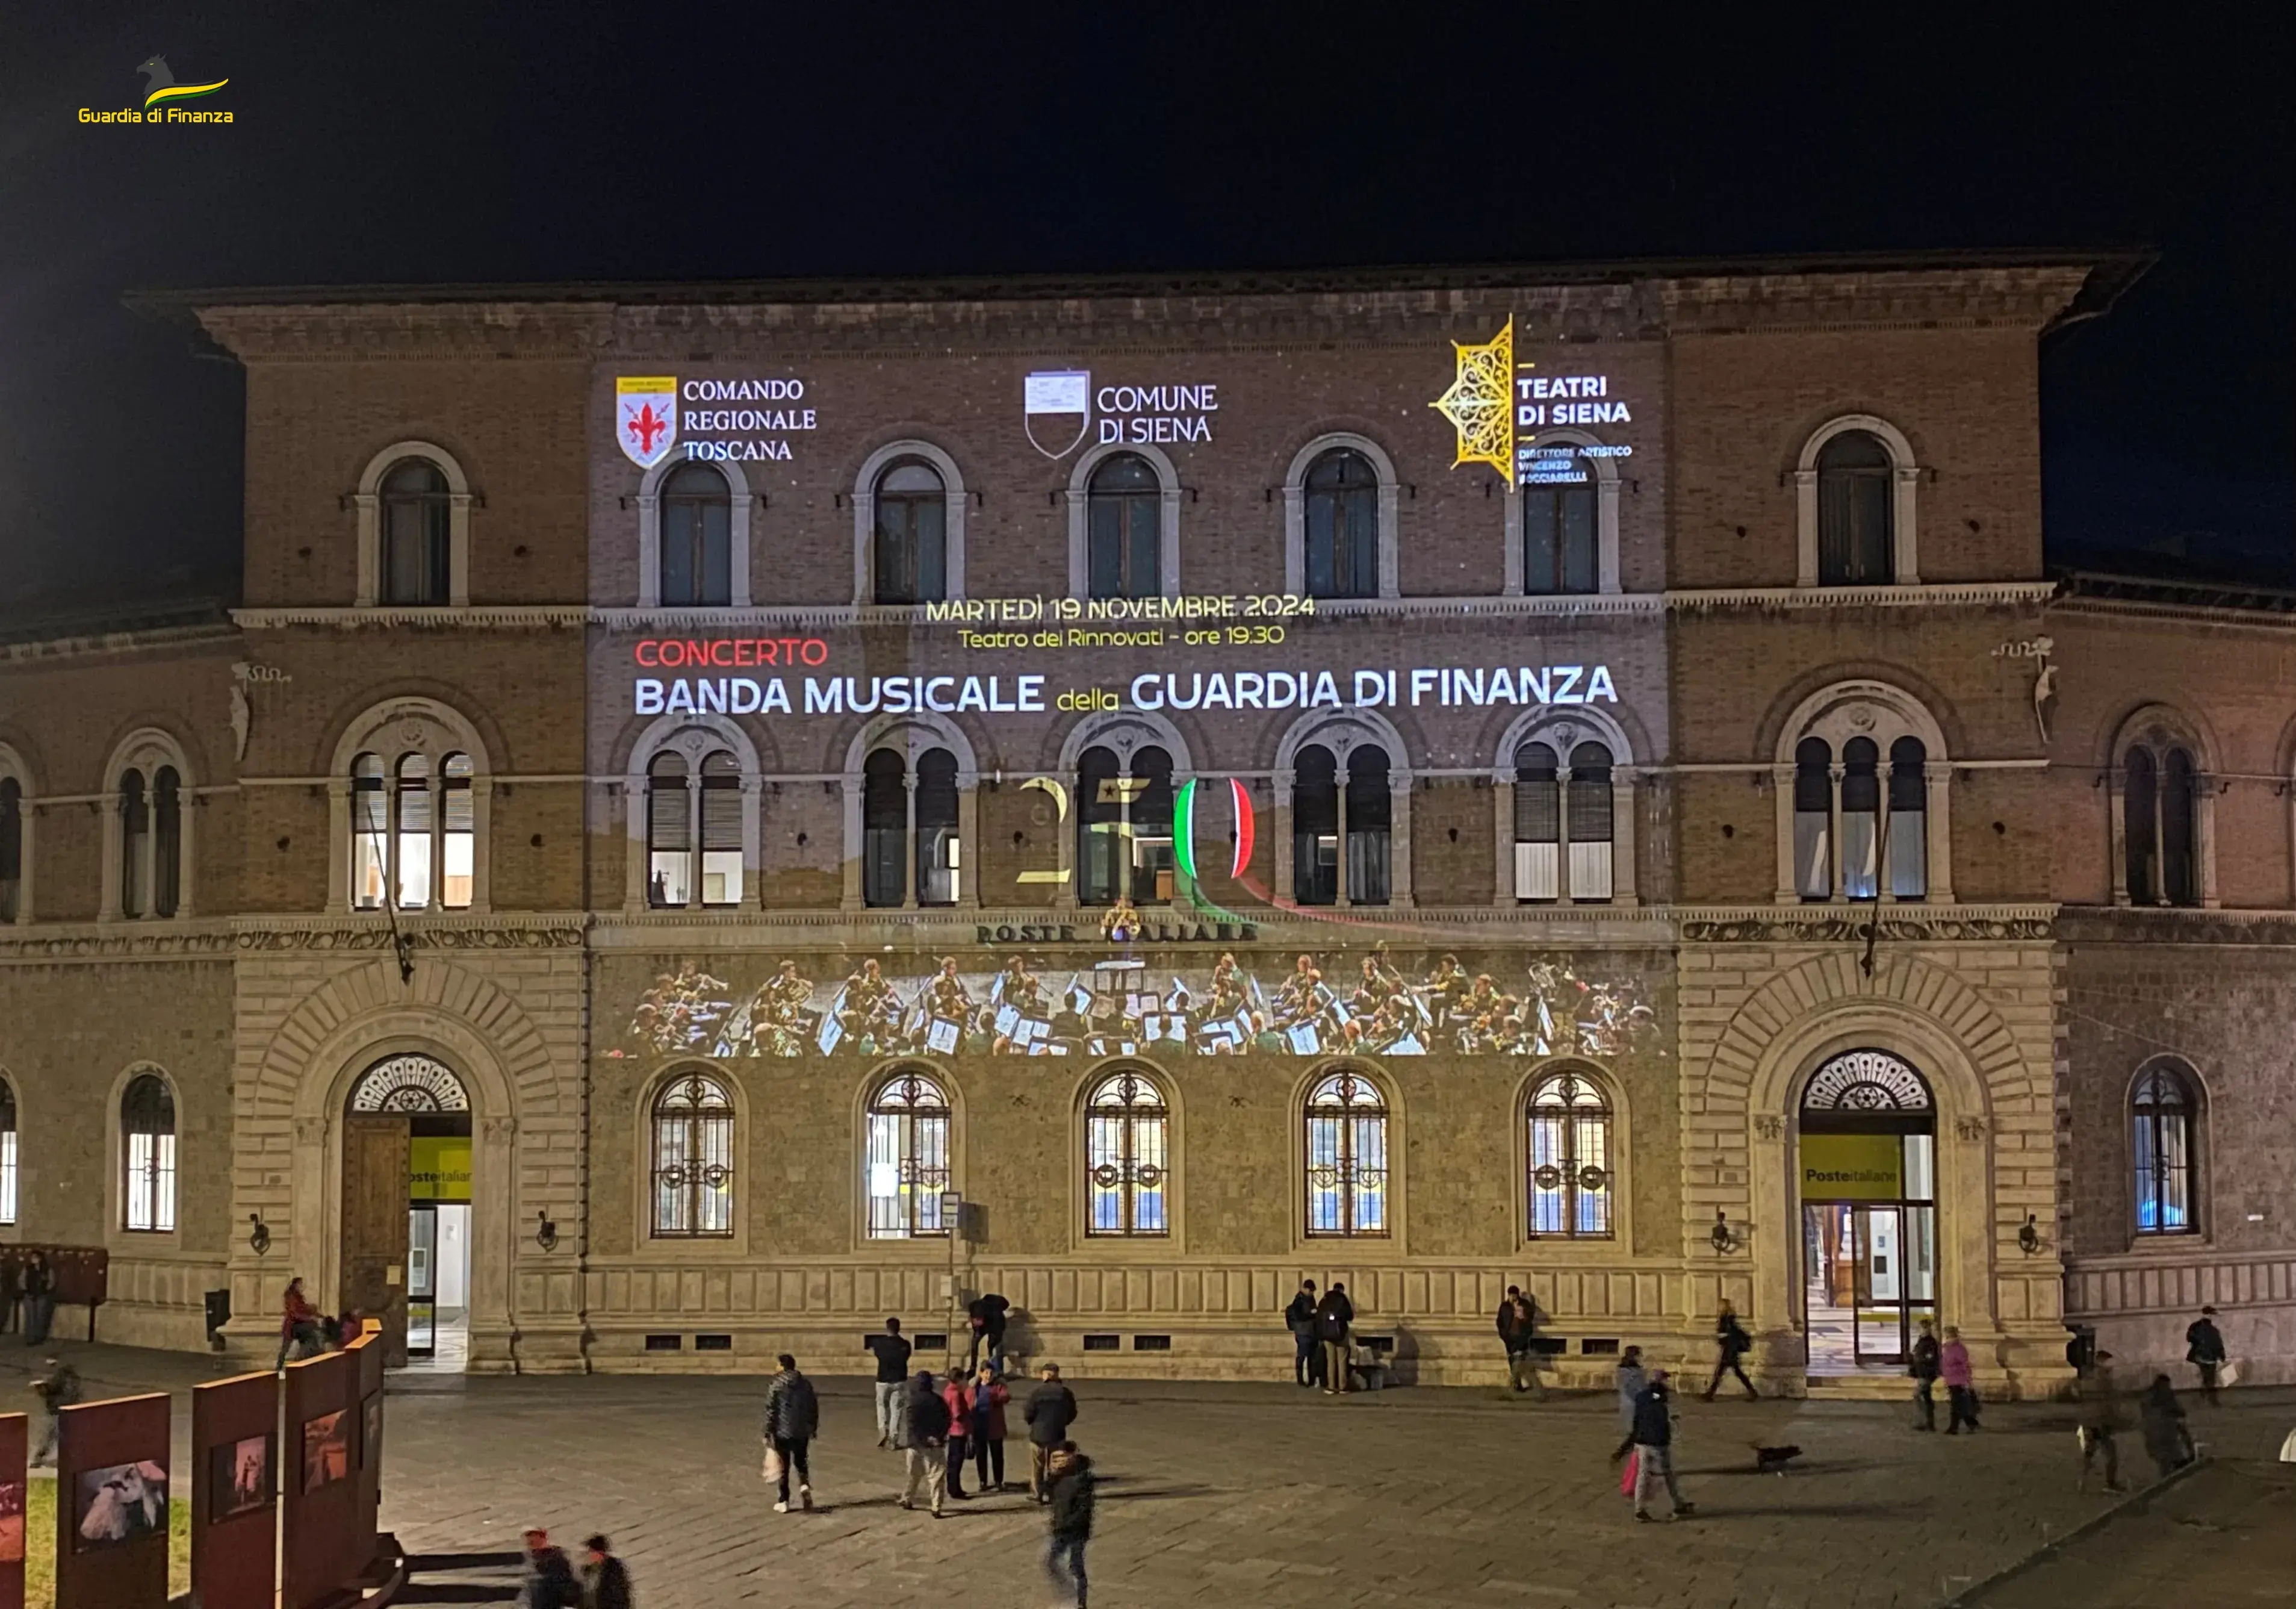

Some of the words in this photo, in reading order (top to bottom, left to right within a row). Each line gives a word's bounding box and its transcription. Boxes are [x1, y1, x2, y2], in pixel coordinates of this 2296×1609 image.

[683, 379, 804, 401] COMANDO
[1097, 385, 1218, 412] COMUNE
[1517, 376, 1607, 399] TEATRI
[683, 410, 817, 431] REGIONALE
[1518, 405, 1545, 426] DI
[1552, 402, 1631, 425] SIENA
[1100, 419, 1123, 443] DI
[1131, 415, 1212, 443] SIENA
[683, 440, 793, 461] TOSCANA
[926, 594, 1043, 621] MARTEDÌ
[1050, 598, 1081, 620] 19
[1088, 596, 1237, 619] NOVEMBRE
[1244, 594, 1315, 617] 2024
[958, 629, 1029, 649] Teatro
[1033, 628, 1063, 647] dei
[1068, 627, 1163, 647] Rinnovati
[1184, 631, 1220, 645] ore
[1227, 626, 1285, 644] 19:30
[635, 639, 828, 667] CONCERTO
[635, 678, 792, 715] BANDA
[804, 675, 1045, 714] MUSICALE
[1056, 689, 1119, 711] della
[1131, 671, 1342, 710] GUARDIA
[1354, 670, 1397, 707] DI
[1411, 666, 1618, 706] FINANZA
[976, 925, 1076, 942] POSTE
